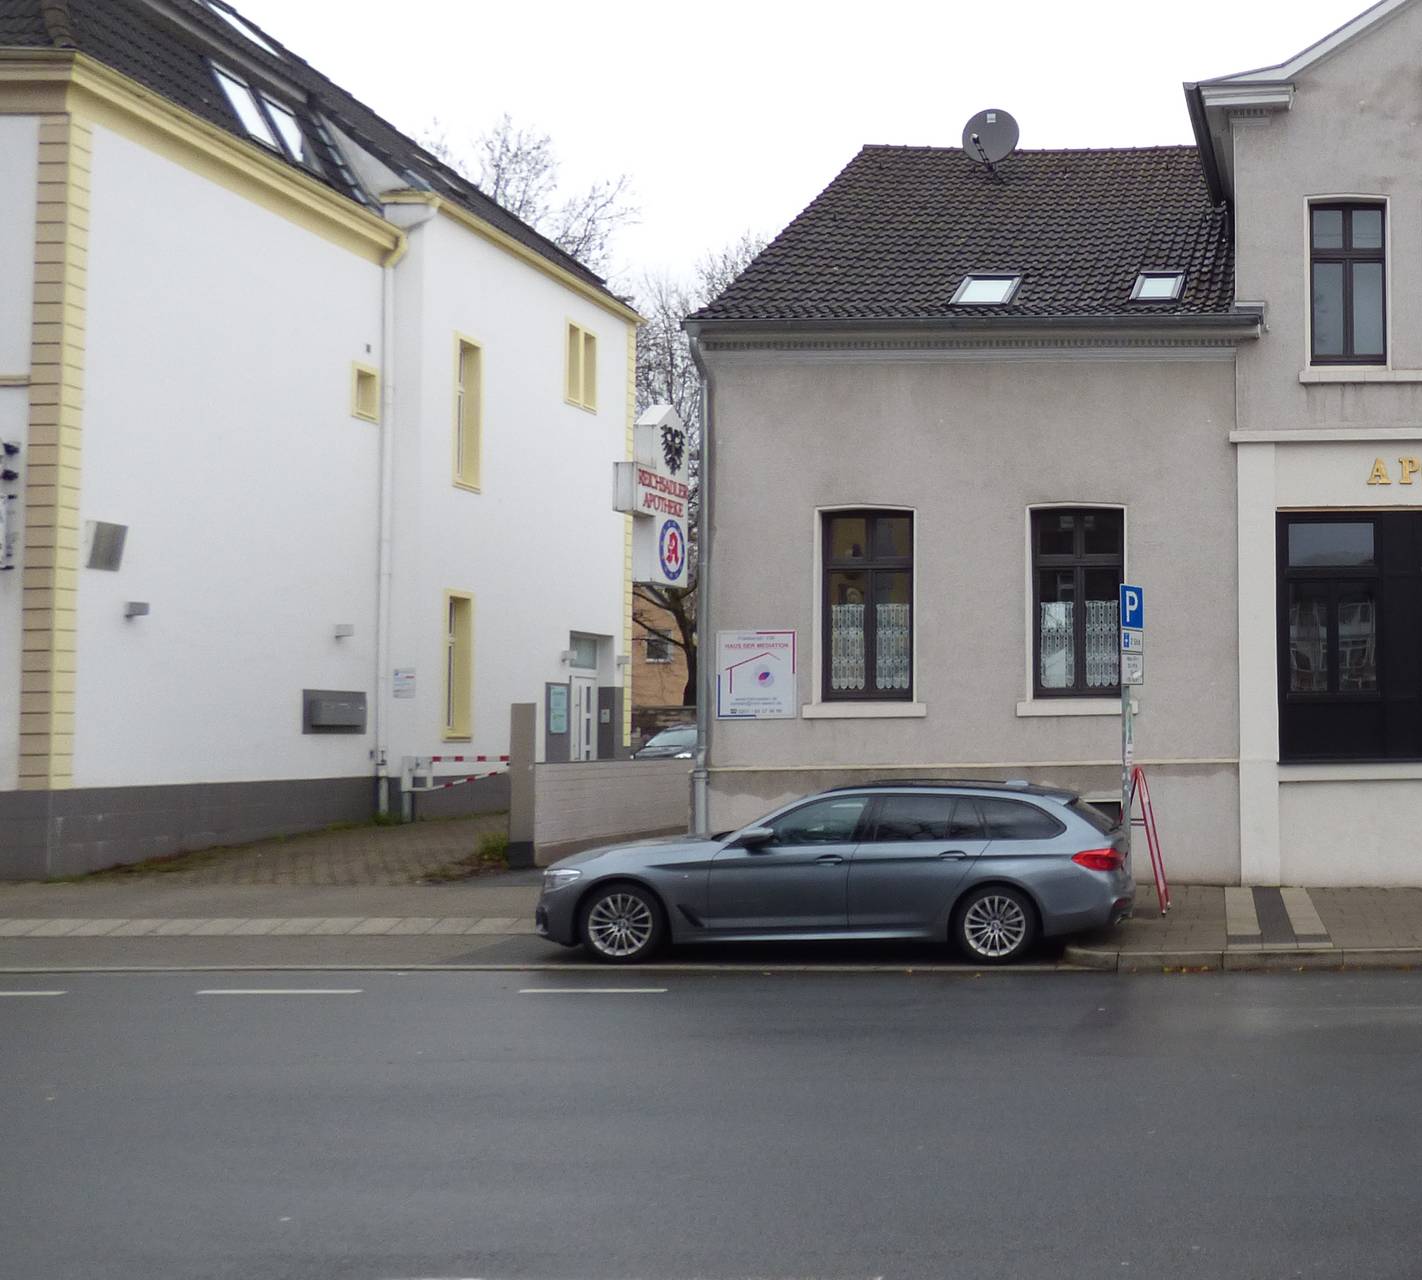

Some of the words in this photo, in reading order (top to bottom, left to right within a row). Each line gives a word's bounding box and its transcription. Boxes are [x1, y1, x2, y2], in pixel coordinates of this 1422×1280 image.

[638, 468, 689, 500] REICHSADLER
[642, 492, 684, 518] APOTHEKE
[1126, 590, 1139, 623] P
